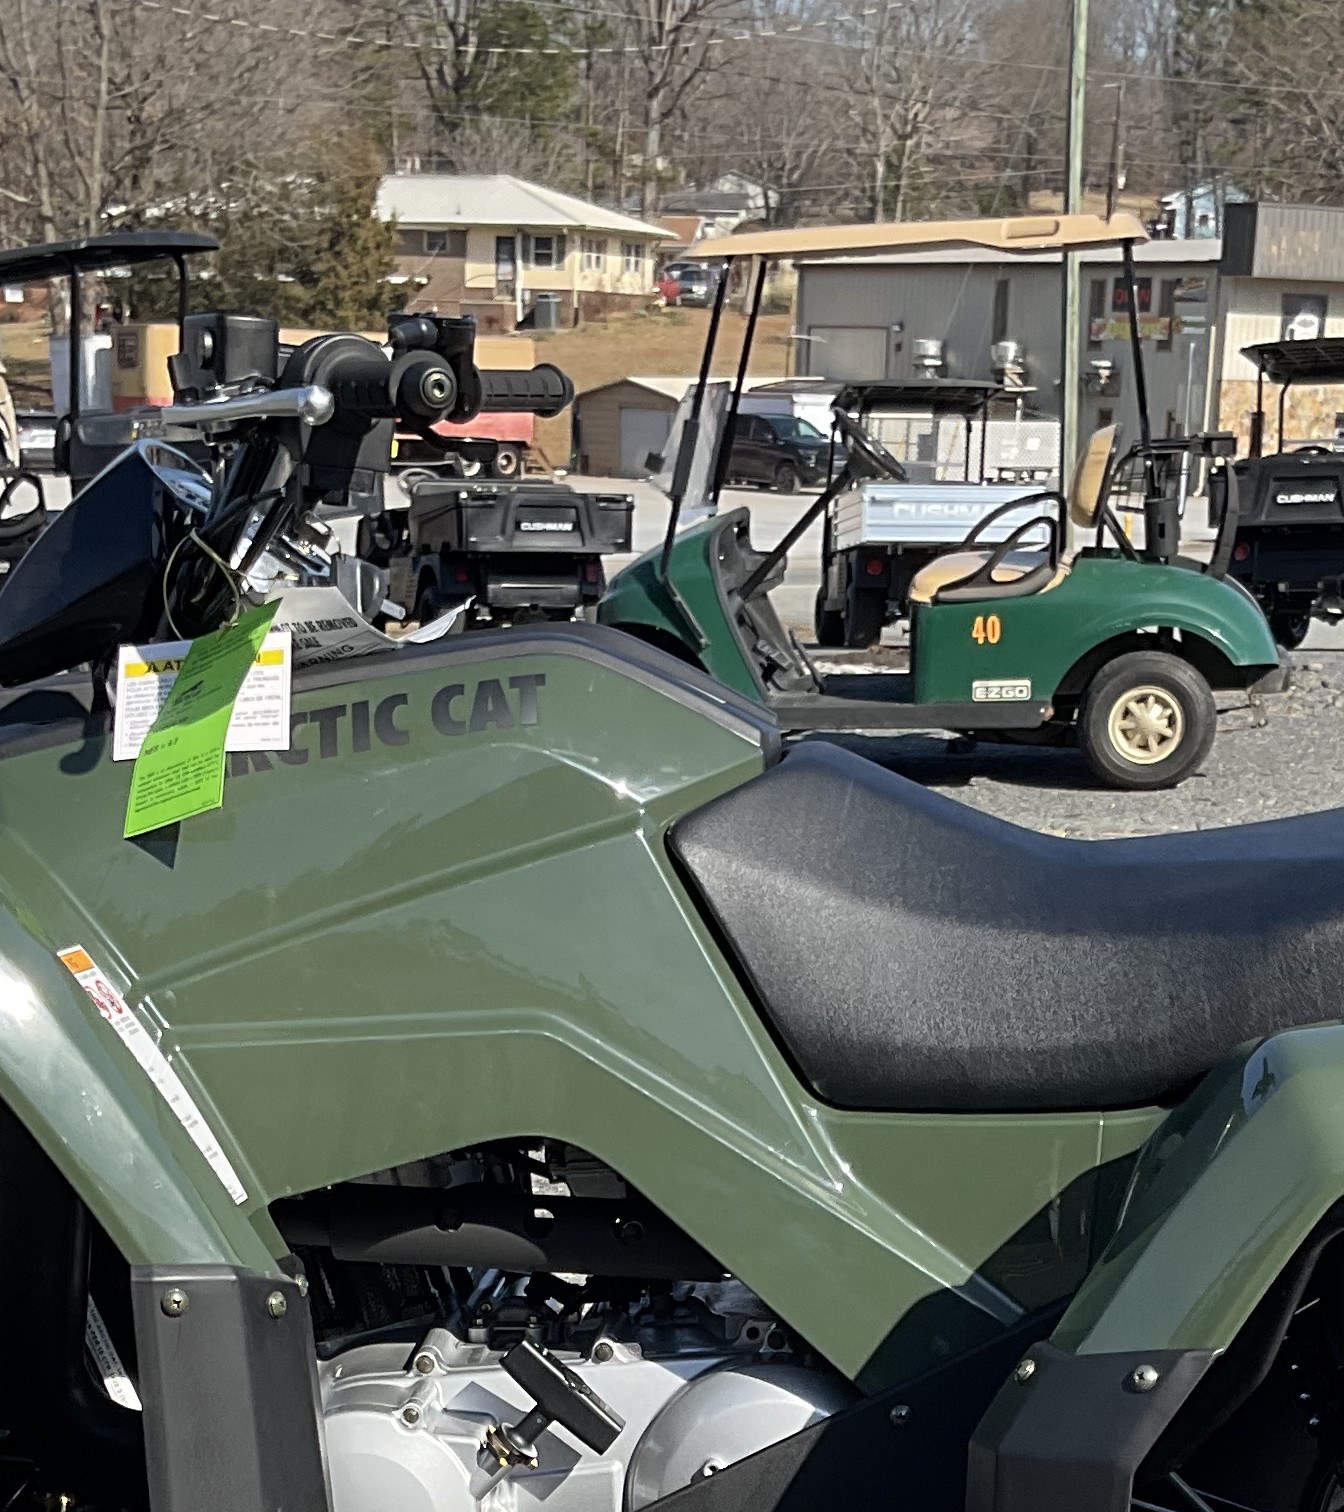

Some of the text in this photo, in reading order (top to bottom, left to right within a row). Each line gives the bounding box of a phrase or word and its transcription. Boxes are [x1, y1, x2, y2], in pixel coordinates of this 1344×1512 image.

[1276, 493, 1336, 505] CUSHMAN
[520, 521, 574, 532] CUSHMAN
[316, 616, 358, 631] REMOVED
[971, 614, 1002, 645] 40
[297, 644, 355, 670] ARNING
[431, 673, 546, 737] CAT
